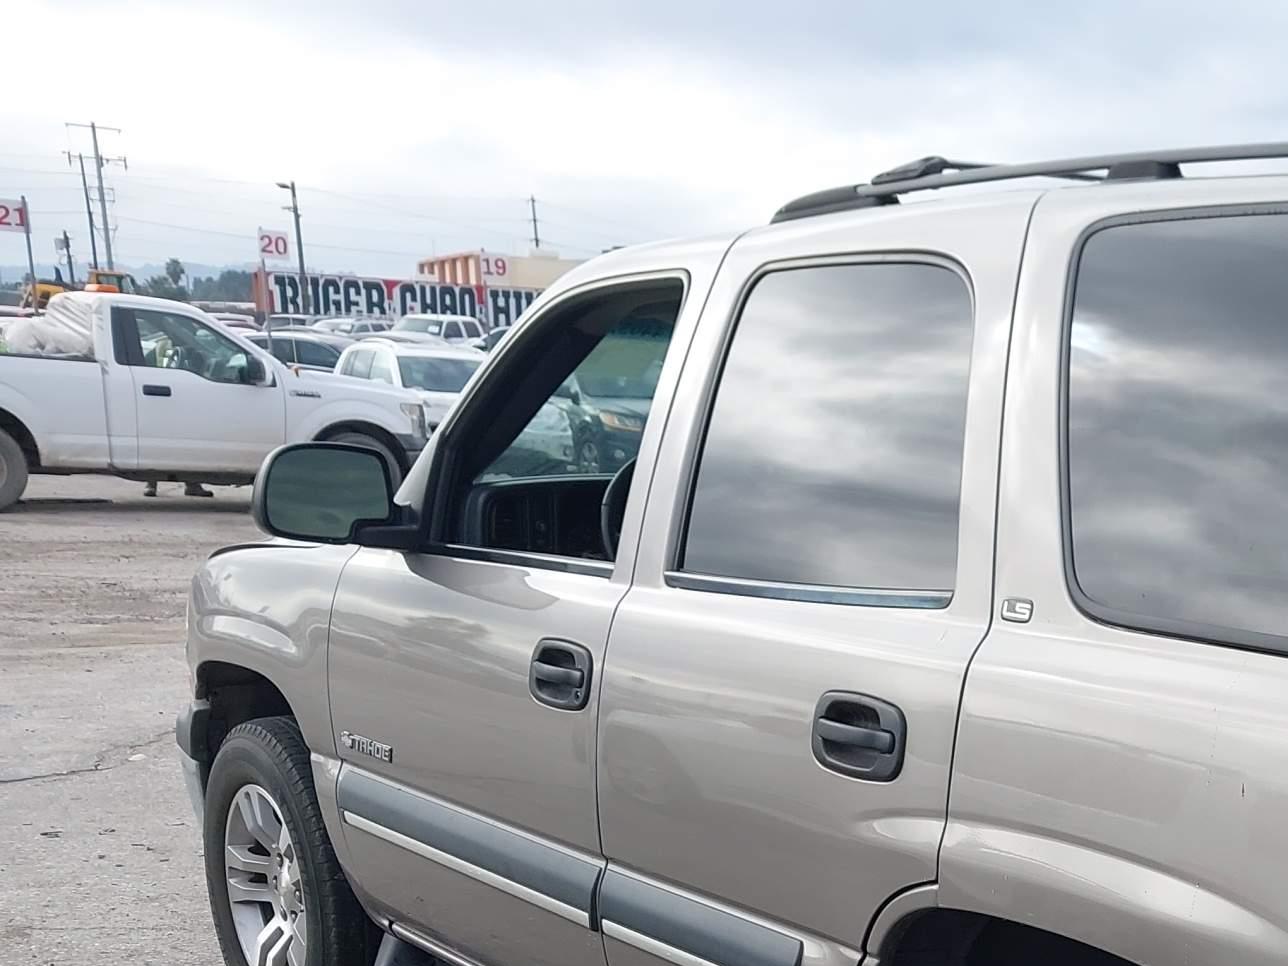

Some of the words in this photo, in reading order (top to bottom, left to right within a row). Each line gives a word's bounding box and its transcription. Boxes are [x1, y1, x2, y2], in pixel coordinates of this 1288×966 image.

[0, 205, 26, 227] 21
[260, 235, 287, 255] 20
[483, 258, 506, 276] 19
[1002, 600, 1032, 620] LS
[350, 735, 391, 762] TAHOE
